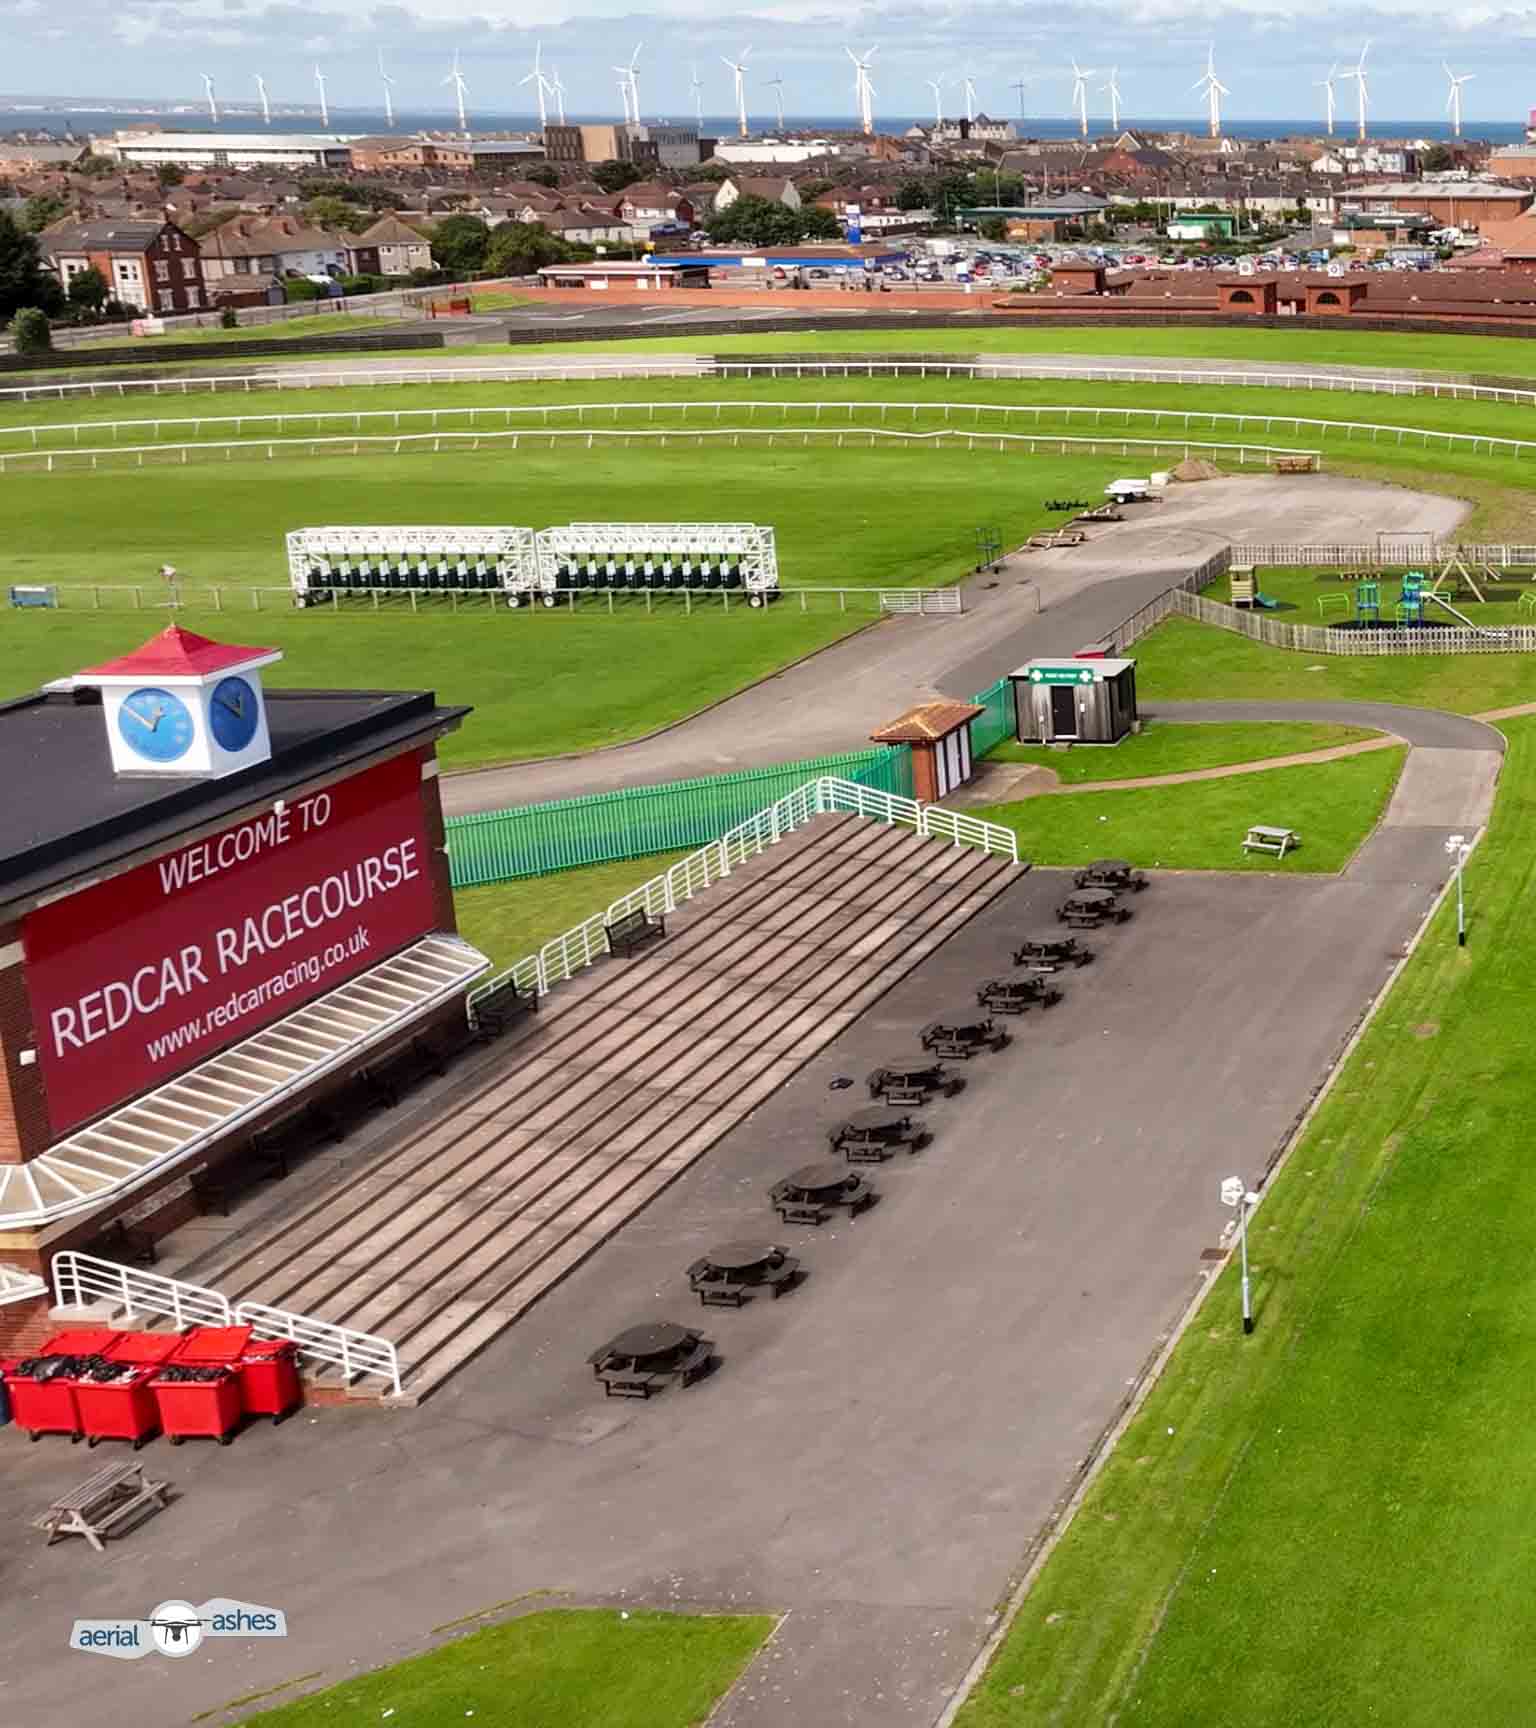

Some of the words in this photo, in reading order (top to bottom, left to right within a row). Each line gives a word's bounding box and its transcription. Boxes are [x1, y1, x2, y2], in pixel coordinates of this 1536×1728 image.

[159, 808, 291, 895] WELCOME
[298, 793, 331, 832] TO
[50, 944, 209, 1058] REDCAR
[215, 837, 420, 974] RACECOURSE
[146, 924, 371, 1063] www.redcarracing.co.uk
